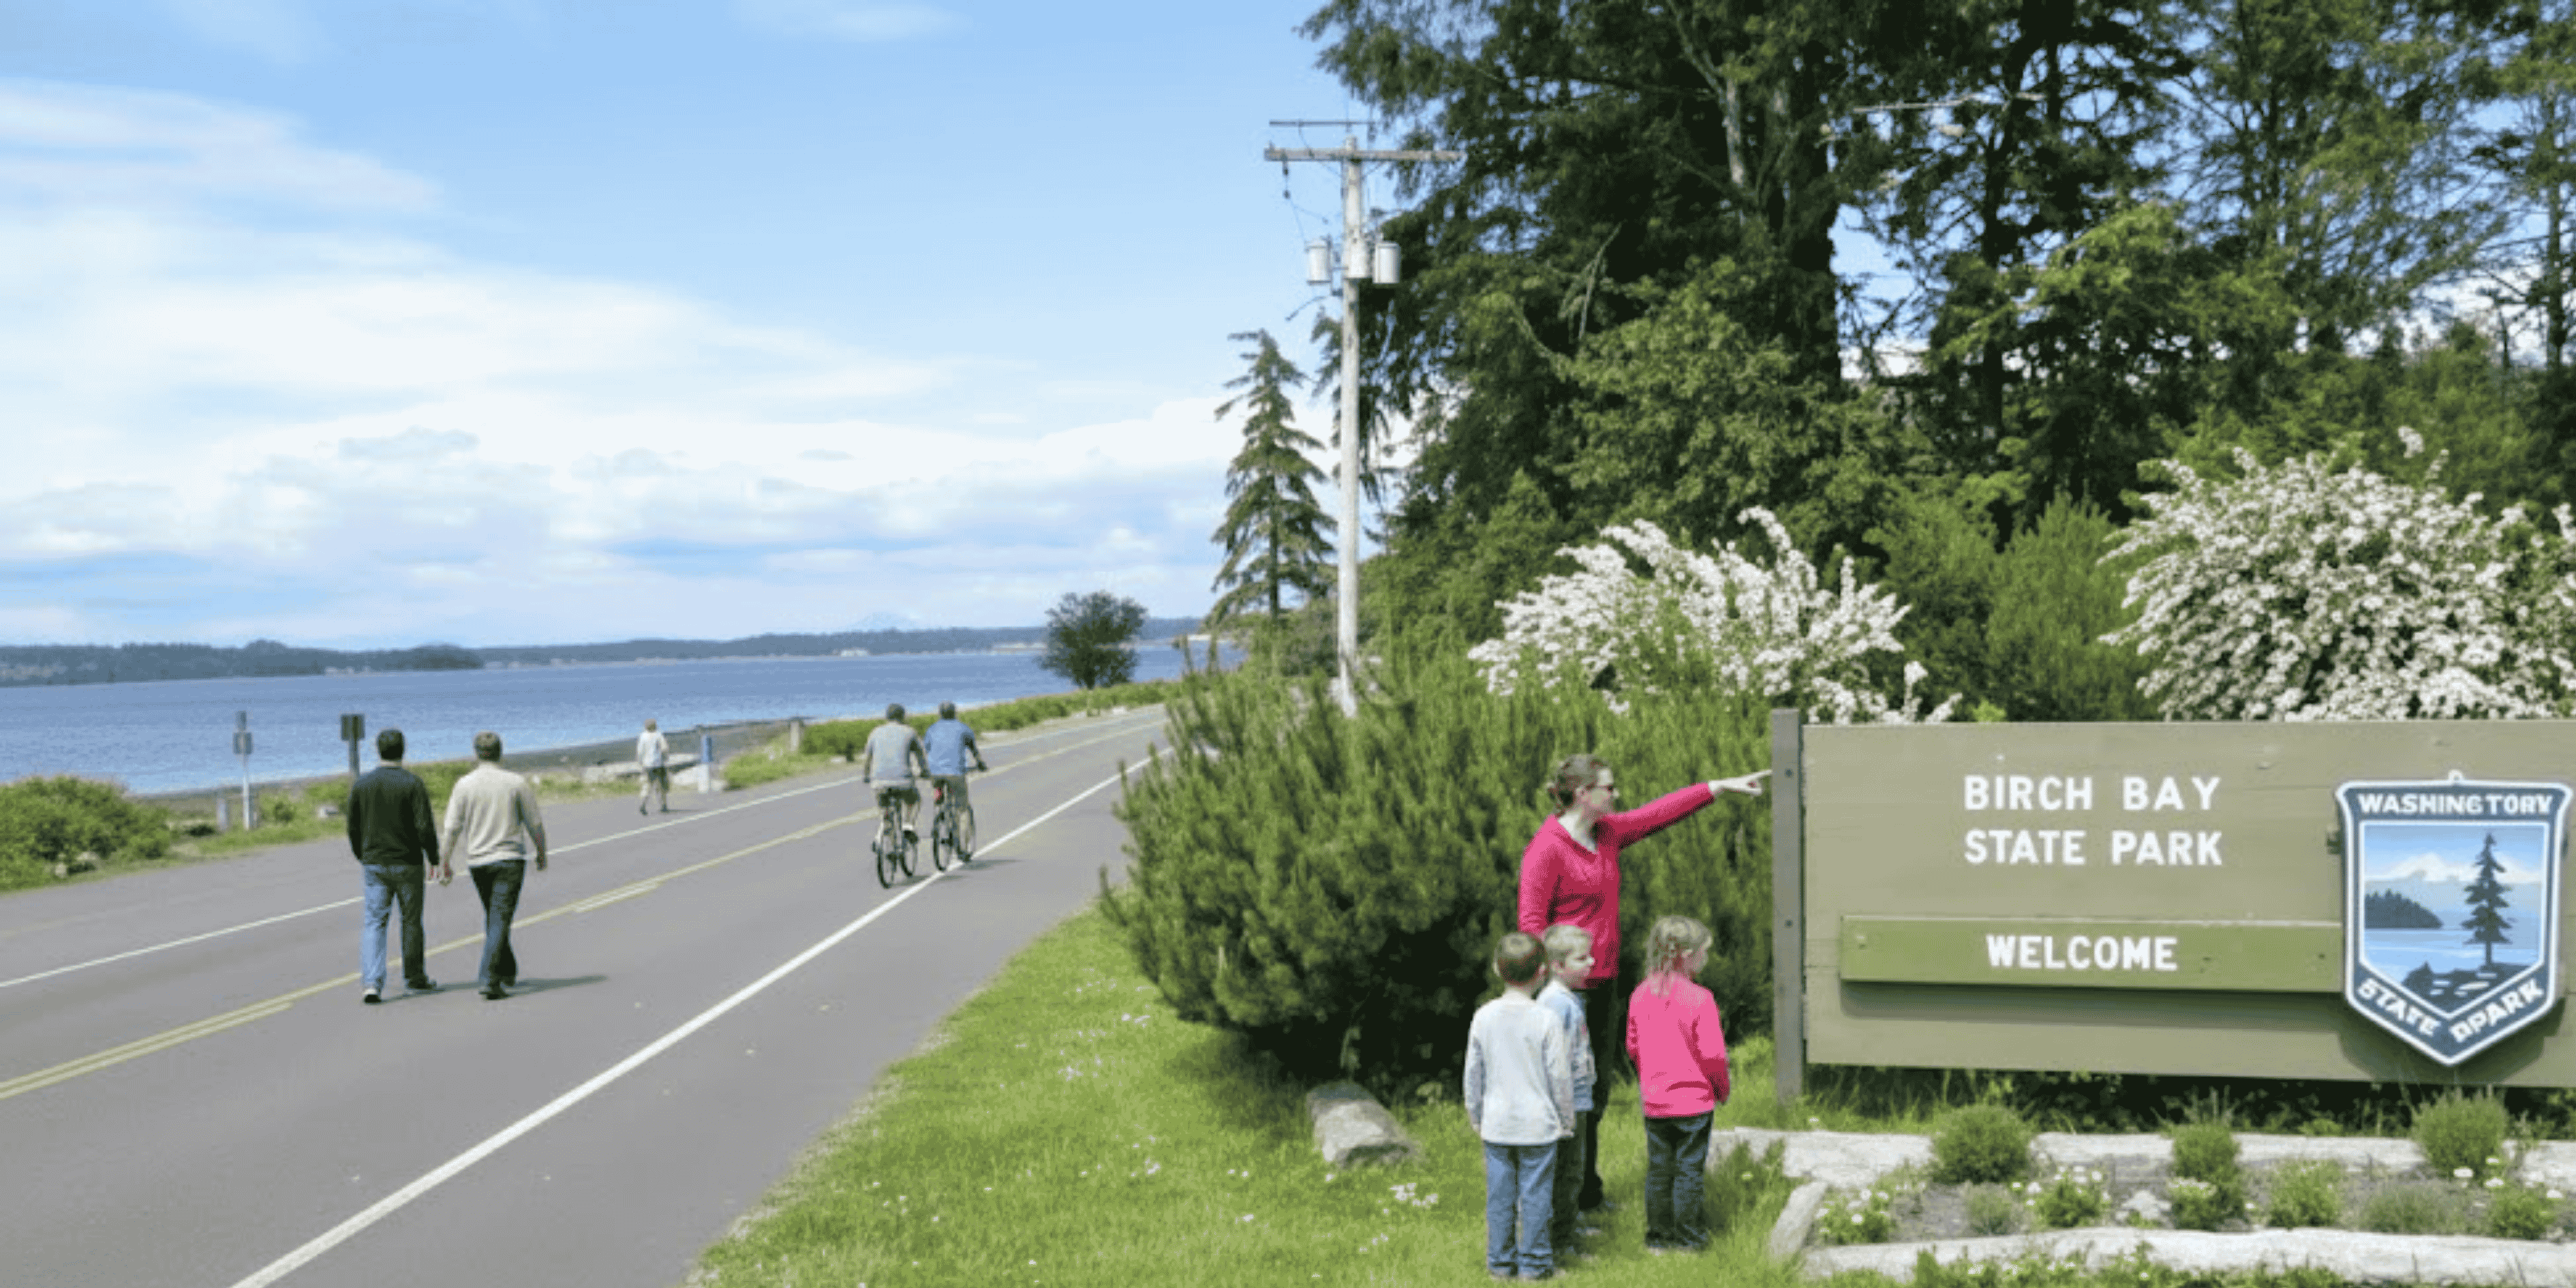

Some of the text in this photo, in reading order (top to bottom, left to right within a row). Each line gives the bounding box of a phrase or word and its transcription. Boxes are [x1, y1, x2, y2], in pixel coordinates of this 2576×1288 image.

[1964, 774, 2221, 811] BIRCH BAY
[1964, 829, 2222, 865] STATE PARK
[1986, 934, 2177, 971] WELCOME
